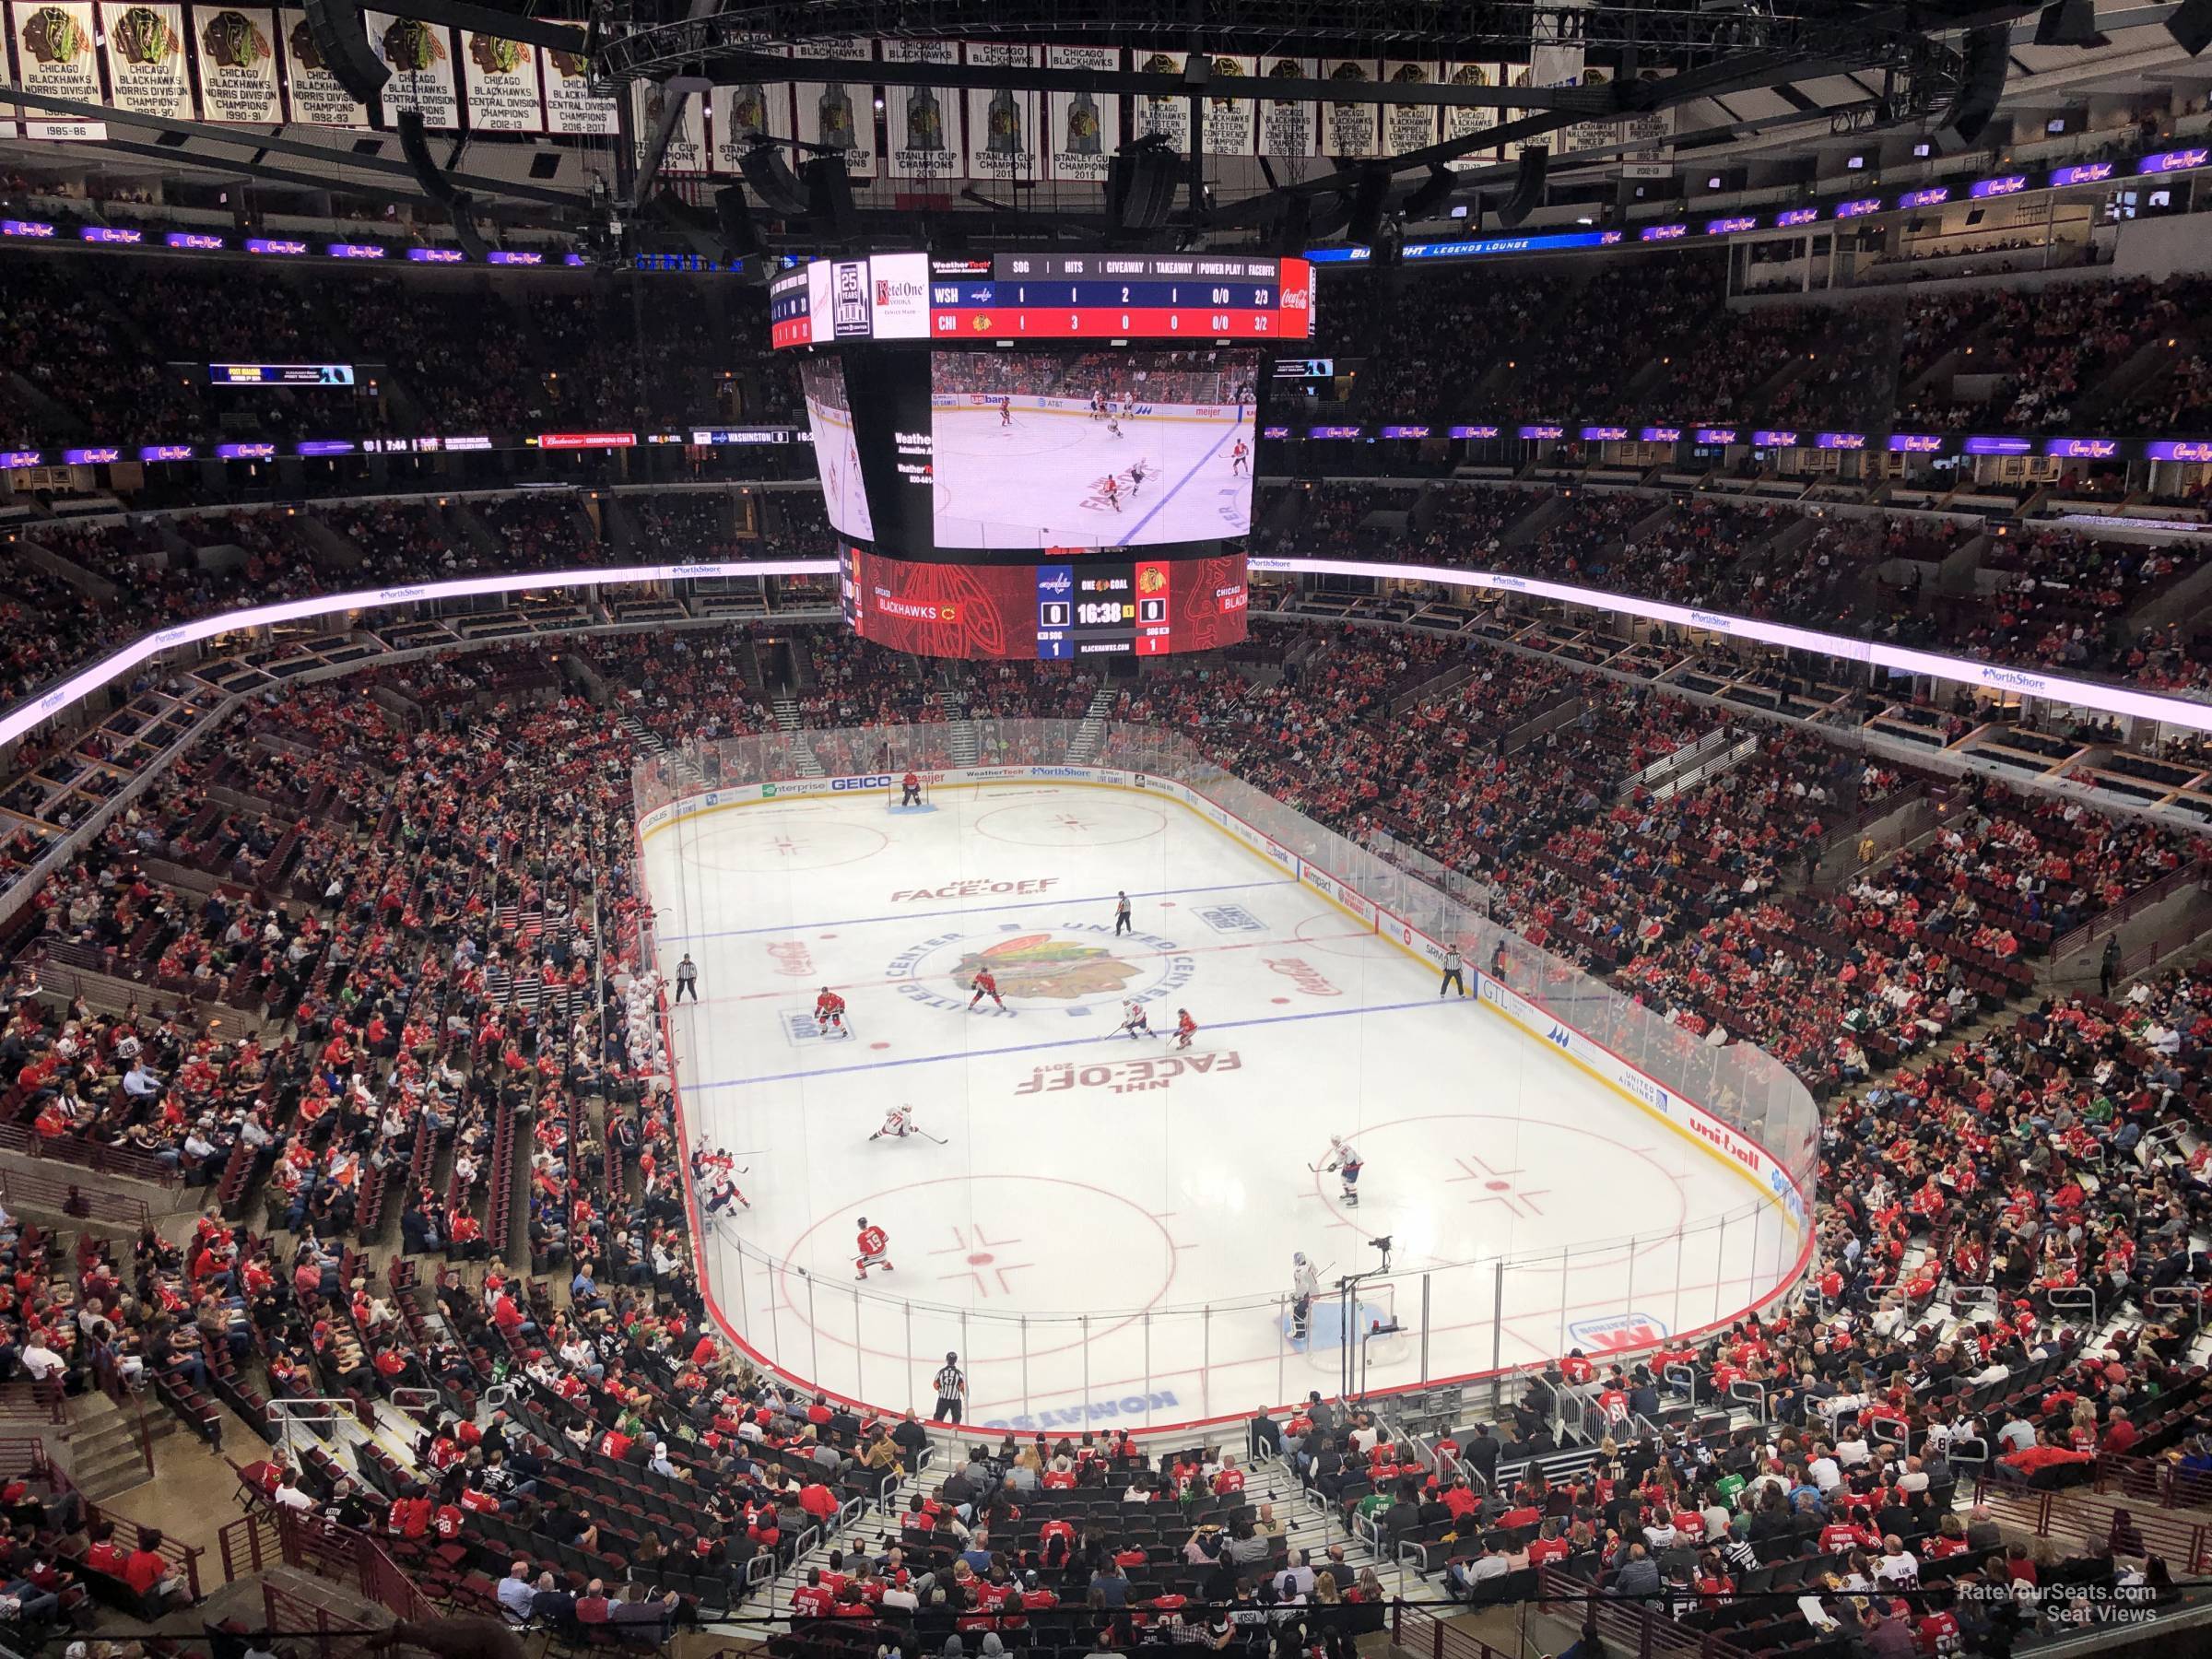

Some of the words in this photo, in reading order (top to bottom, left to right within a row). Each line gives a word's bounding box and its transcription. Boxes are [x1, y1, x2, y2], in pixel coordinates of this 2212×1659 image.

[801, 48, 865, 57] BLACKHAWKS
[889, 50, 952, 59] BLACKHAWKS
[983, 46, 1024, 55] CHICAGO
[1064, 49, 1103, 58] CHICAGO
[973, 54, 1033, 64] BLACKHAWKS
[1053, 57, 1113, 67] BLACKHAWKS
[39, 64, 79, 73] CHICAGO
[130, 65, 169, 75] CHICAGO
[219, 68, 258, 77] CHICAGO
[29, 75, 91, 84] BLACKHAWKS
[120, 75, 182, 85] BLACKHAWKS
[209, 78, 271, 89] BLACKHAWKS
[398, 74, 436, 84] CHICAGO
[484, 76, 520, 86] CHICAGO
[25, 85, 57, 94] NORRIS
[61, 86, 99, 95] DIVISION
[115, 87, 148, 96] NORRIS
[151, 87, 188, 96] DIVISION
[206, 88, 238, 99] NORRIS
[241, 89, 276, 100] DIVISION
[389, 84, 447, 94] BLACKHAWKS
[475, 86, 531, 96] BLACKHAWKS
[126, 97, 179, 106] CHAMPIONS
[216, 100, 268, 110] CHAMPIONS
[423, 95, 455, 105] DIVISION
[469, 97, 505, 106] CENTRAL
[508, 98, 540, 108] DIVISION
[304, 102, 355, 112] CHAMPIONS
[547, 100, 584, 110] CENTRAL
[586, 101, 617, 112] DIVISION
[226, 112, 261, 121] 1990-91
[312, 112, 348, 123] 1992-93
[481, 108, 529, 118] CHAMPIONS
[559, 112, 606, 122] CHAMPIONS
[490, 120, 523, 129] 2012-13
[562, 123, 606, 133] 2016-2017
[678, 144, 699, 153] CUP
[852, 151, 870, 159] CUP
[895, 152, 934, 161] STANLEY
[938, 152, 957, 160] CUP
[975, 152, 1014, 161] STANLEY
[1054, 154, 1092, 163] STANLEY
[900, 160, 954, 170] CHAMPIONS
[980, 161, 1032, 170] CHAMPIONS
[1059, 162, 1110, 171] CHAMPIONS
[1433, 244, 1482, 254] LEGENDS
[1486, 241, 1529, 251] LOUNGE
[933, 261, 991, 269] WeatherTech
[1013, 261, 1030, 273] SOG
[1065, 261, 1083, 273] HITS
[1106, 261, 1144, 274] GIVEAWAY
[1156, 262, 1193, 274] TAKEAWAY
[1200, 263, 1224, 275] POWER
[1225, 264, 1241, 275] PLAY
[1248, 265, 1275, 276] FACEOFFS
[841, 273, 857, 291] 25
[841, 290, 858, 300] YEARS
[905, 283, 923, 297] One
[935, 288, 959, 303] WSH
[1122, 287, 1129, 302] 2
[1212, 288, 1230, 304] 0/0
[1254, 289, 1268, 305] 2/3
[938, 315, 957, 331] CHI
[1071, 314, 1078, 330] 3
[1122, 314, 1129, 330] 0
[1171, 315, 1178, 330] 0
[1212, 315, 1229, 331] 0/0
[1254, 316, 1267, 331] 3/2
[1196, 408, 1220, 418] meijer
[545, 436, 583, 445] Budweiser
[728, 433, 771, 442] WASHINGTON
[386, 441, 406, 451] 7:44
[1250, 559, 1291, 568] NorthShore
[1082, 581, 1095, 590] ONE
[1110, 579, 1128, 589] GOAL
[1216, 584, 1241, 597] CHICAGO
[878, 598, 936, 620] BLACKHAWKS
[1050, 605, 1061, 623] 0
[1077, 602, 1122, 624] 16:38
[1147, 602, 1158, 619] 0
[1694, 612, 1731, 628] NorthShore
[1049, 631, 1063, 640] SOG
[1147, 628, 1159, 636] SOG
[1053, 642, 1060, 656] 1
[1081, 643, 1130, 653] BLACKHAWKS.COM
[1149, 639, 1157, 651] 1
[1988, 669, 2045, 689] NorthShore
[967, 769, 1024, 778] WeatherTech
[1037, 767, 1091, 777] NorthShore
[831, 776, 891, 790] GEICO
[1097, 775, 1107, 783] LIVE
[1107, 776, 1123, 785] GAMES
[767, 782, 825, 794] enterprise
[645, 810, 667, 827] LEXUS
[1273, 846, 1288, 864] bank
[1306, 865, 1332, 894] impact
[890, 878, 1060, 902] FACE-OFF
[886, 932, 964, 977] CENTER
[1483, 980, 1508, 1010] GTL
[1033, 1062, 1074, 1073] 2019
[1014, 1051, 1242, 1096] FACE-OFF
[1109, 1079, 1170, 1094] NHL
[1626, 1071, 1654, 1094] UNITED
[1618, 1077, 1653, 1103] AIRLINES
[888, 1113, 903, 1127] 77
[944, 1376, 954, 1385] 47
[325, 1507, 342, 1516] KEITH
[439, 1519, 453, 1534] 88
[1898, 1567, 1911, 1575] KANE
[798, 1594, 819, 1606] MIKITA
[987, 1594, 1001, 1603] SAAD
